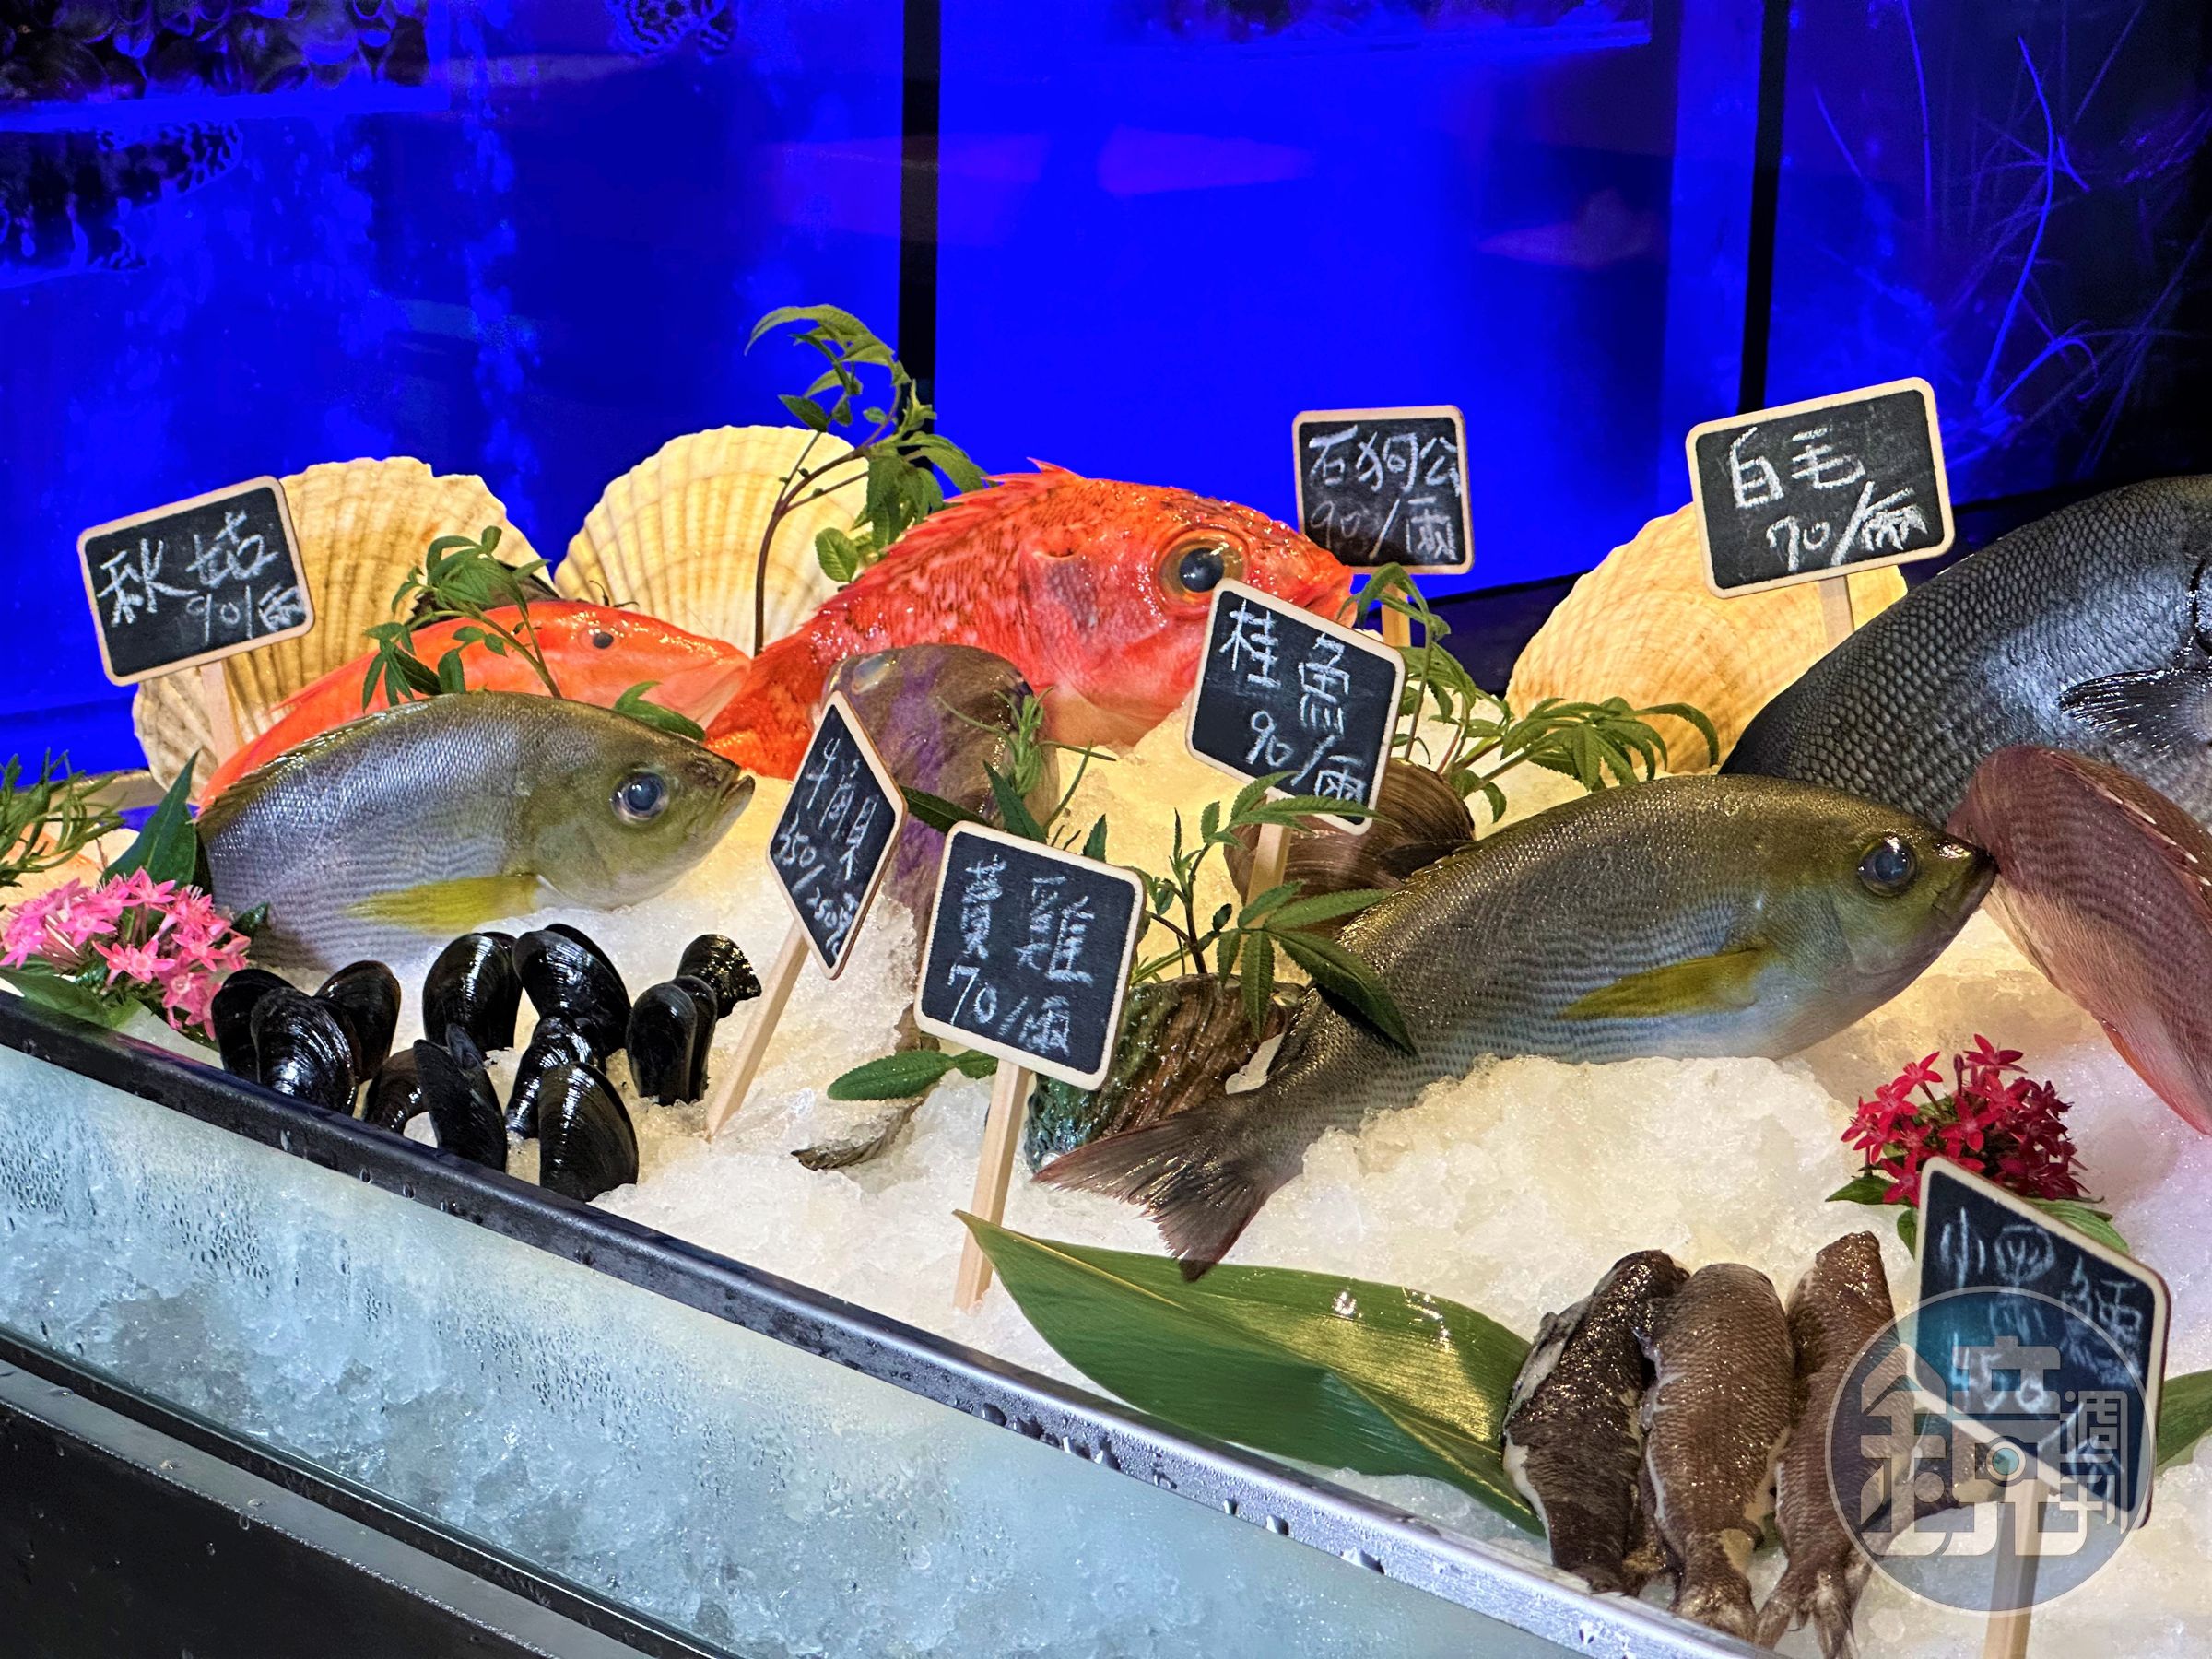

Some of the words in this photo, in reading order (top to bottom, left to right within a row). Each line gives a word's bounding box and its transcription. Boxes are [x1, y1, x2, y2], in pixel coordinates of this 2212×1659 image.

[1309, 424, 1462, 498] 石狗公
[1729, 426, 1867, 509] 白毛
[97, 510, 278, 628] 秋姑
